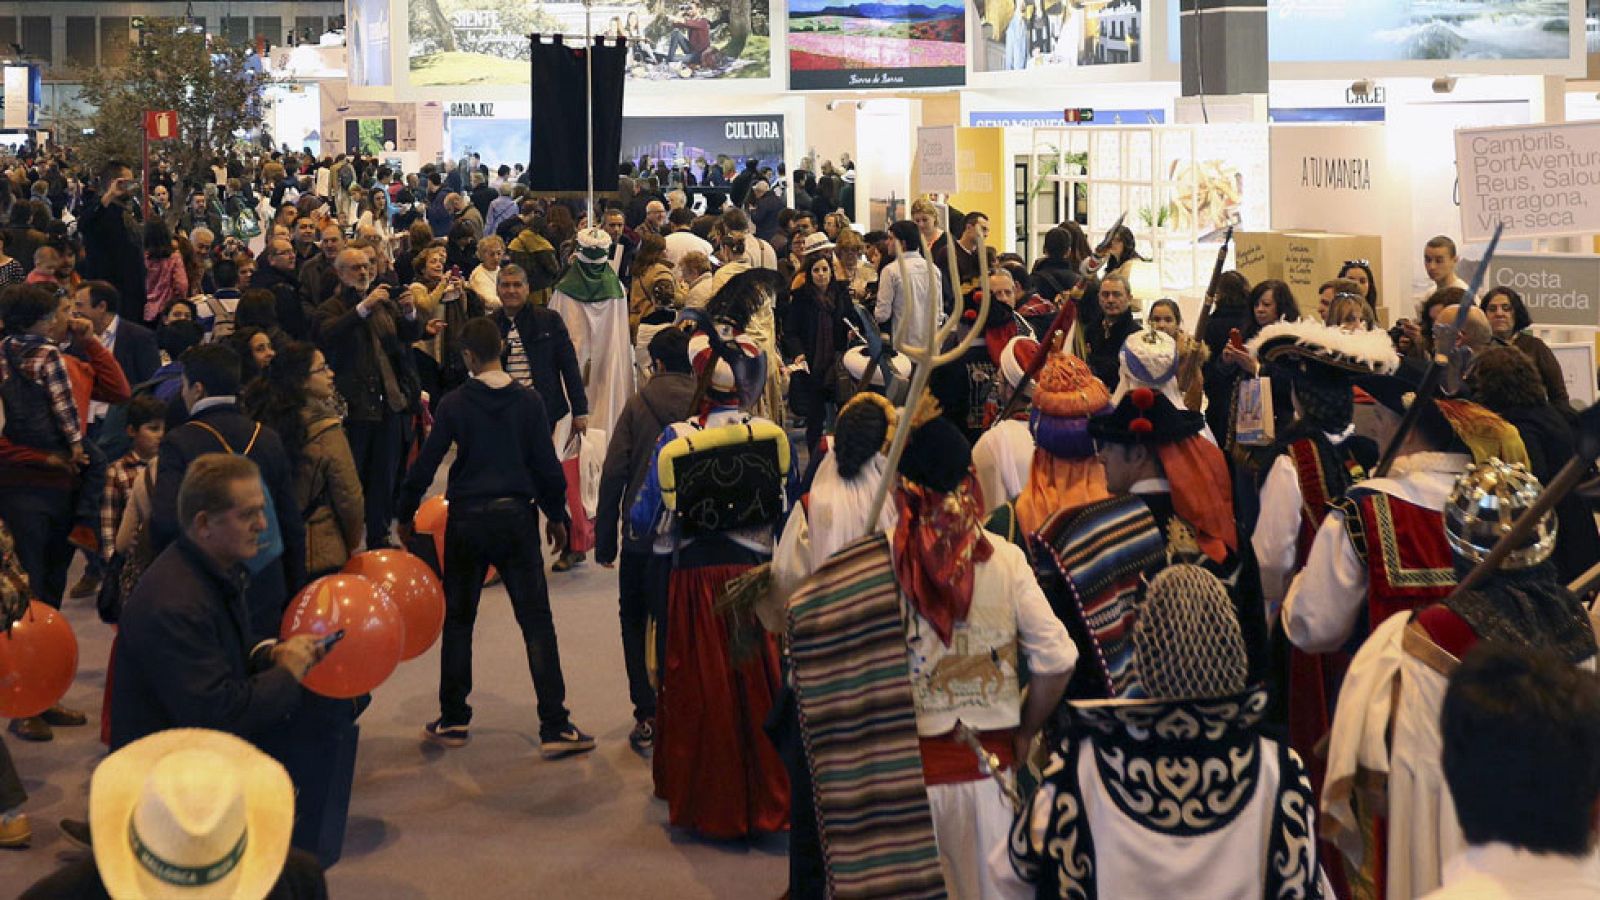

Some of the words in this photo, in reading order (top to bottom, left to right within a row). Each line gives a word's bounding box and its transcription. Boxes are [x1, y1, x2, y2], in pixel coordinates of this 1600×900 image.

[1344, 86, 1387, 104] CACE
[725, 121, 780, 140] CULTURA
[1472, 132, 1571, 156] Cambrils,
[1301, 156, 1309, 187] A
[1311, 156, 1323, 189] TU
[1325, 157, 1371, 190] MANERA
[1473, 150, 1600, 175] PortAventur
[1475, 174, 1536, 194] Reus,
[1476, 190, 1588, 213] Tarragona,
[1496, 267, 1563, 290] Costa
[1518, 290, 1591, 310] urada
